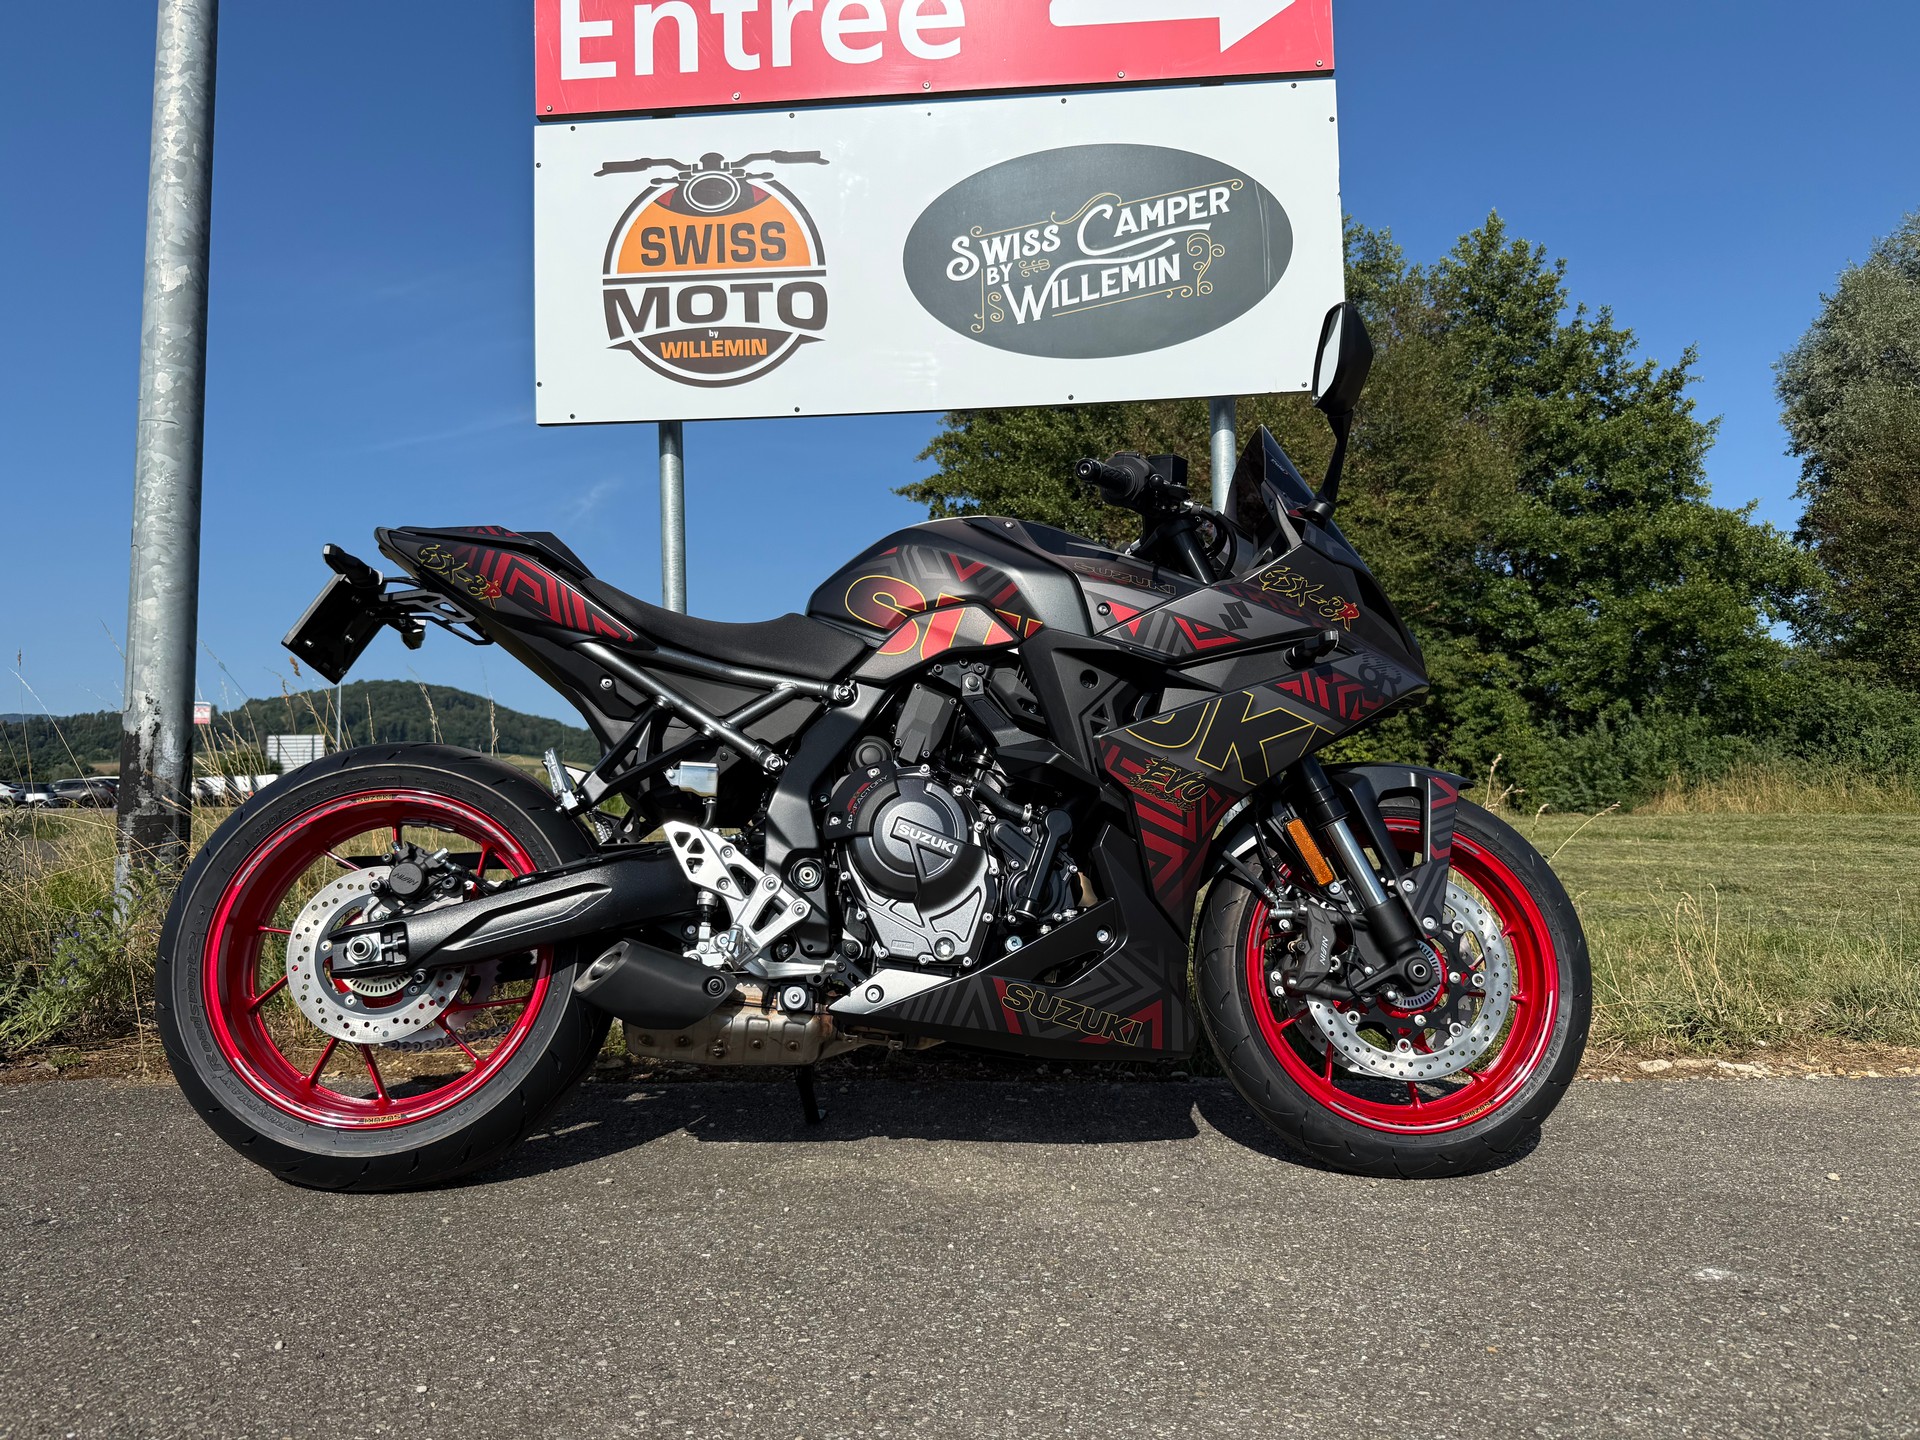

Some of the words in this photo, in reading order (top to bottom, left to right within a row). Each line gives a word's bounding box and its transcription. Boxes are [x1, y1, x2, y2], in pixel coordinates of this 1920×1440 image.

[640, 221, 787, 267] SWISS
[946, 225, 1061, 281] SWISS
[1077, 186, 1230, 256] CAMPER
[986, 262, 1013, 286] BY
[1002, 238, 1181, 325] WILLEMIN
[603, 281, 828, 340] MOTO
[660, 338, 768, 359] WILLEMIN
[708, 329, 719, 339] by
[1073, 560, 1177, 597] SUZUKI
[898, 824, 958, 855] SUZUKI
[1002, 983, 1143, 1046] SUZUKI
[363, 1114, 401, 1124] SUZUKI
